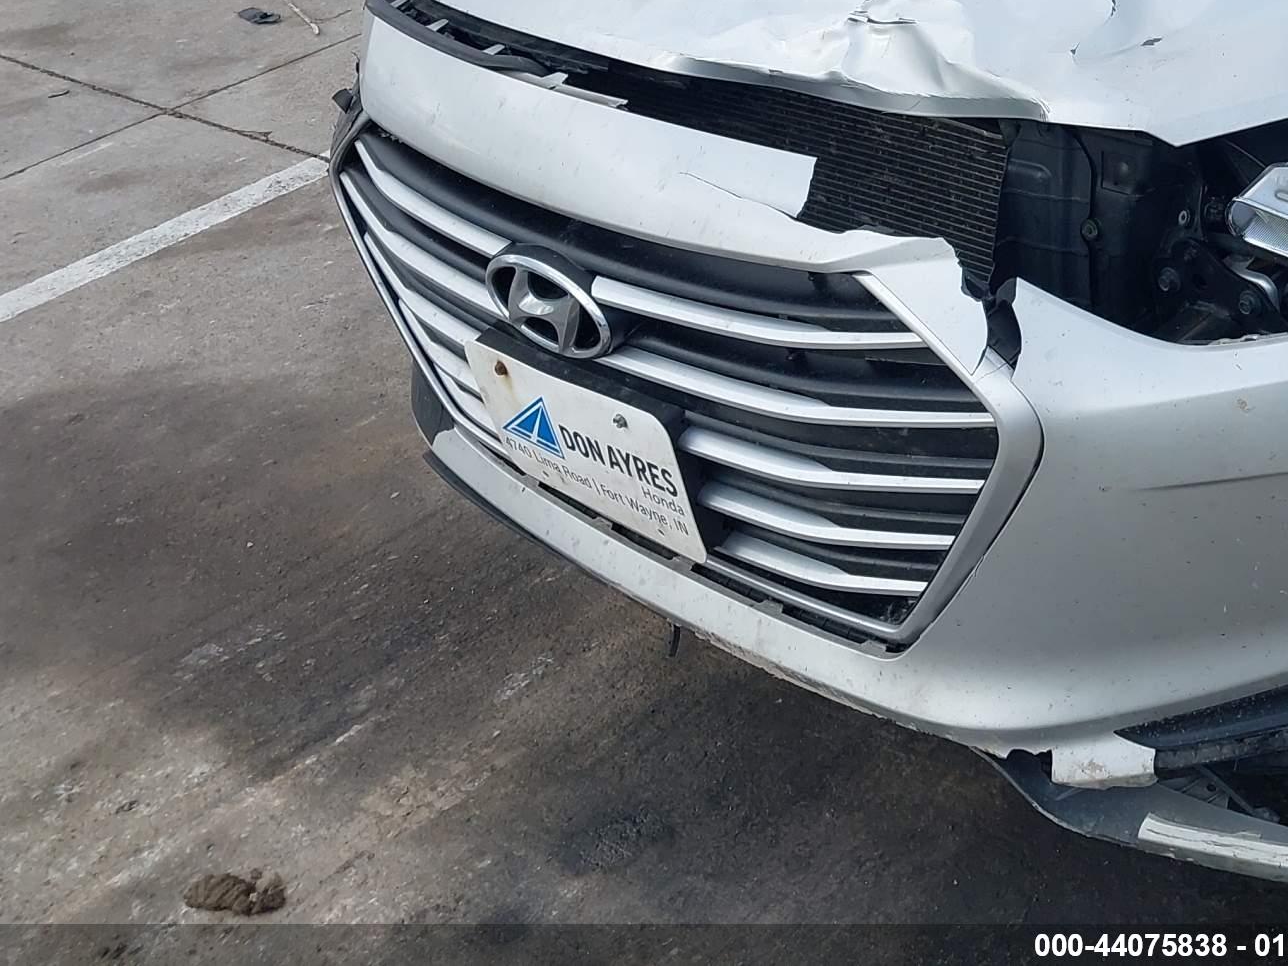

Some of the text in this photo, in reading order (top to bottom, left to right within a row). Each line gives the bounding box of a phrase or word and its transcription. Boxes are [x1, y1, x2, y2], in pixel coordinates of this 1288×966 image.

[506, 436, 532, 459] 4740
[532, 449, 562, 474] Lima
[561, 465, 593, 489] Road
[600, 483, 625, 506] Fort
[625, 495, 673, 529] Wayne,
[673, 518, 689, 536] IN
[558, 424, 678, 498] DON AYRES
[641, 485, 685, 516] Honda
